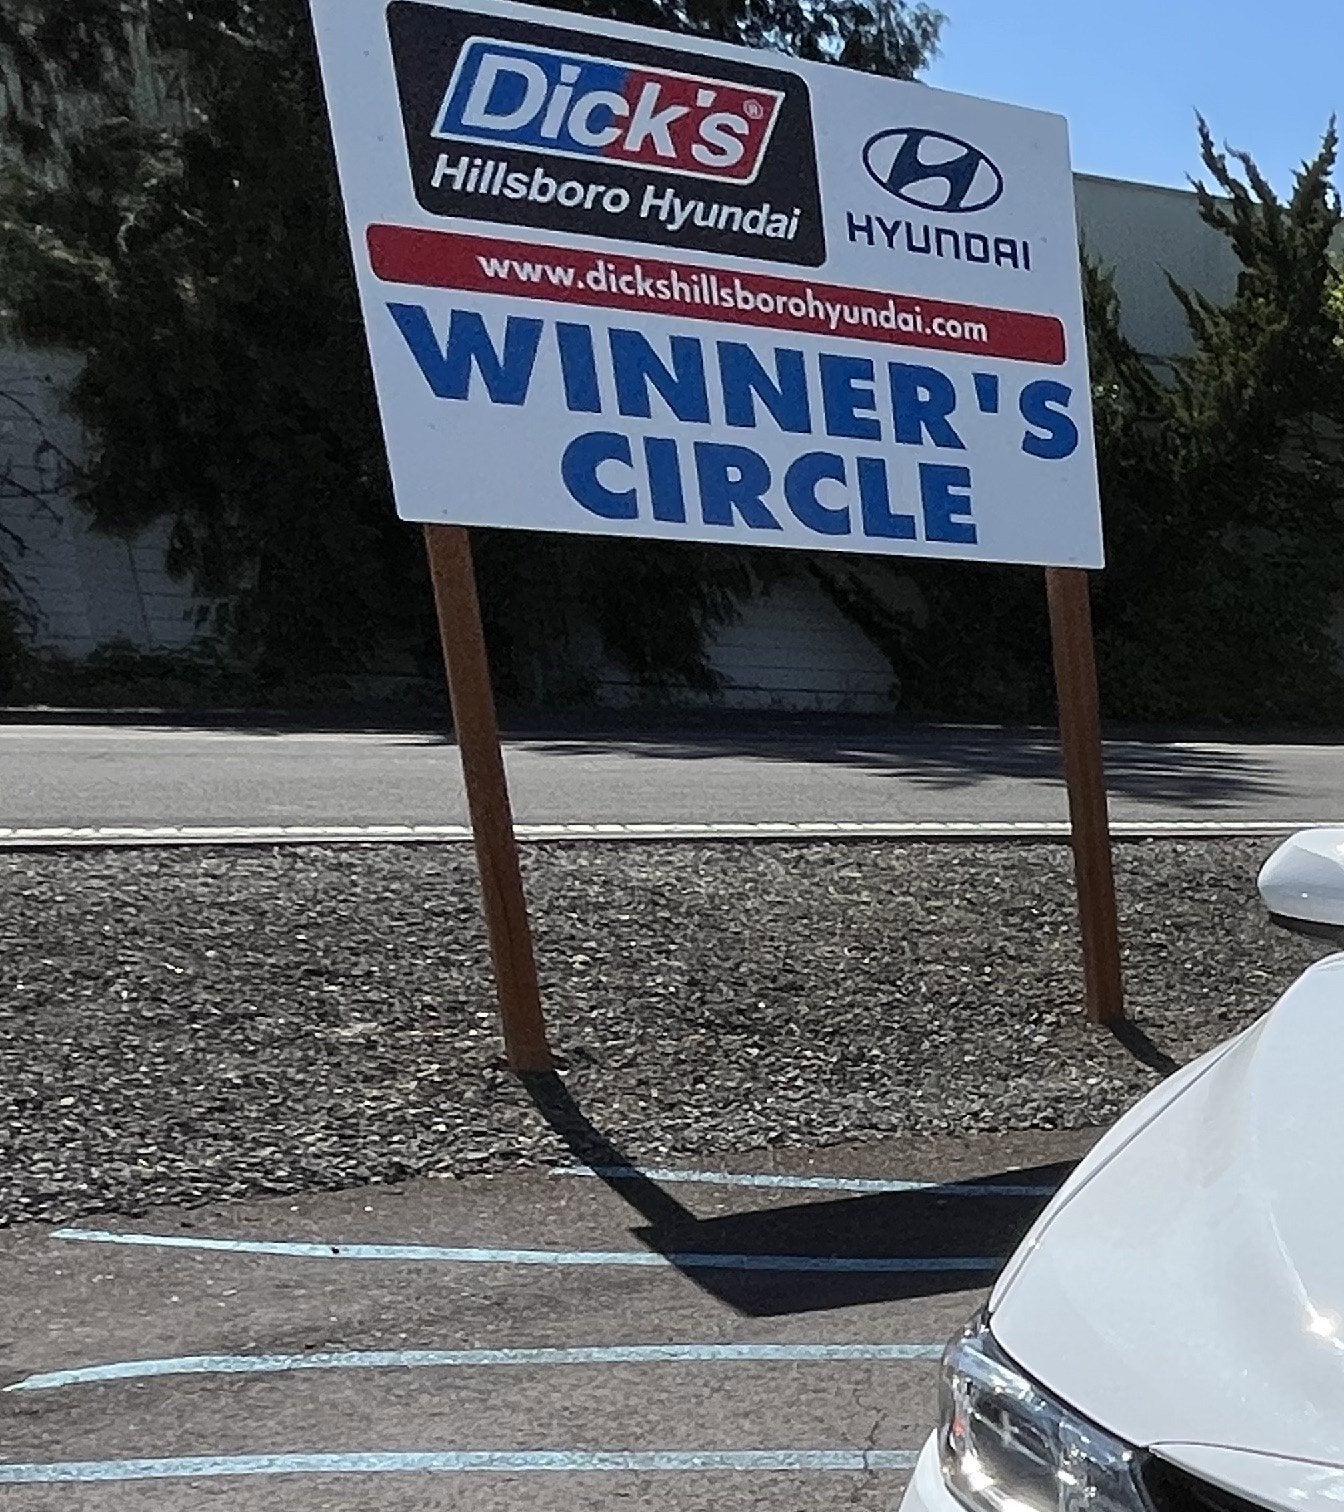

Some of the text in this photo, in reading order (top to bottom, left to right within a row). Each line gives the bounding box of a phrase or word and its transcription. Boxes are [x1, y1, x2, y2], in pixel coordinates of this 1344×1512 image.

[461, 52, 750, 167] Dick's
[431, 153, 801, 240] Hillsboro Hyundai
[846, 211, 1032, 271] HYUNDAI
[478, 252, 989, 345] www.dickshillsborohyundai.com
[386, 302, 1080, 460] WINNER'S
[560, 430, 977, 545] CIRCLE
